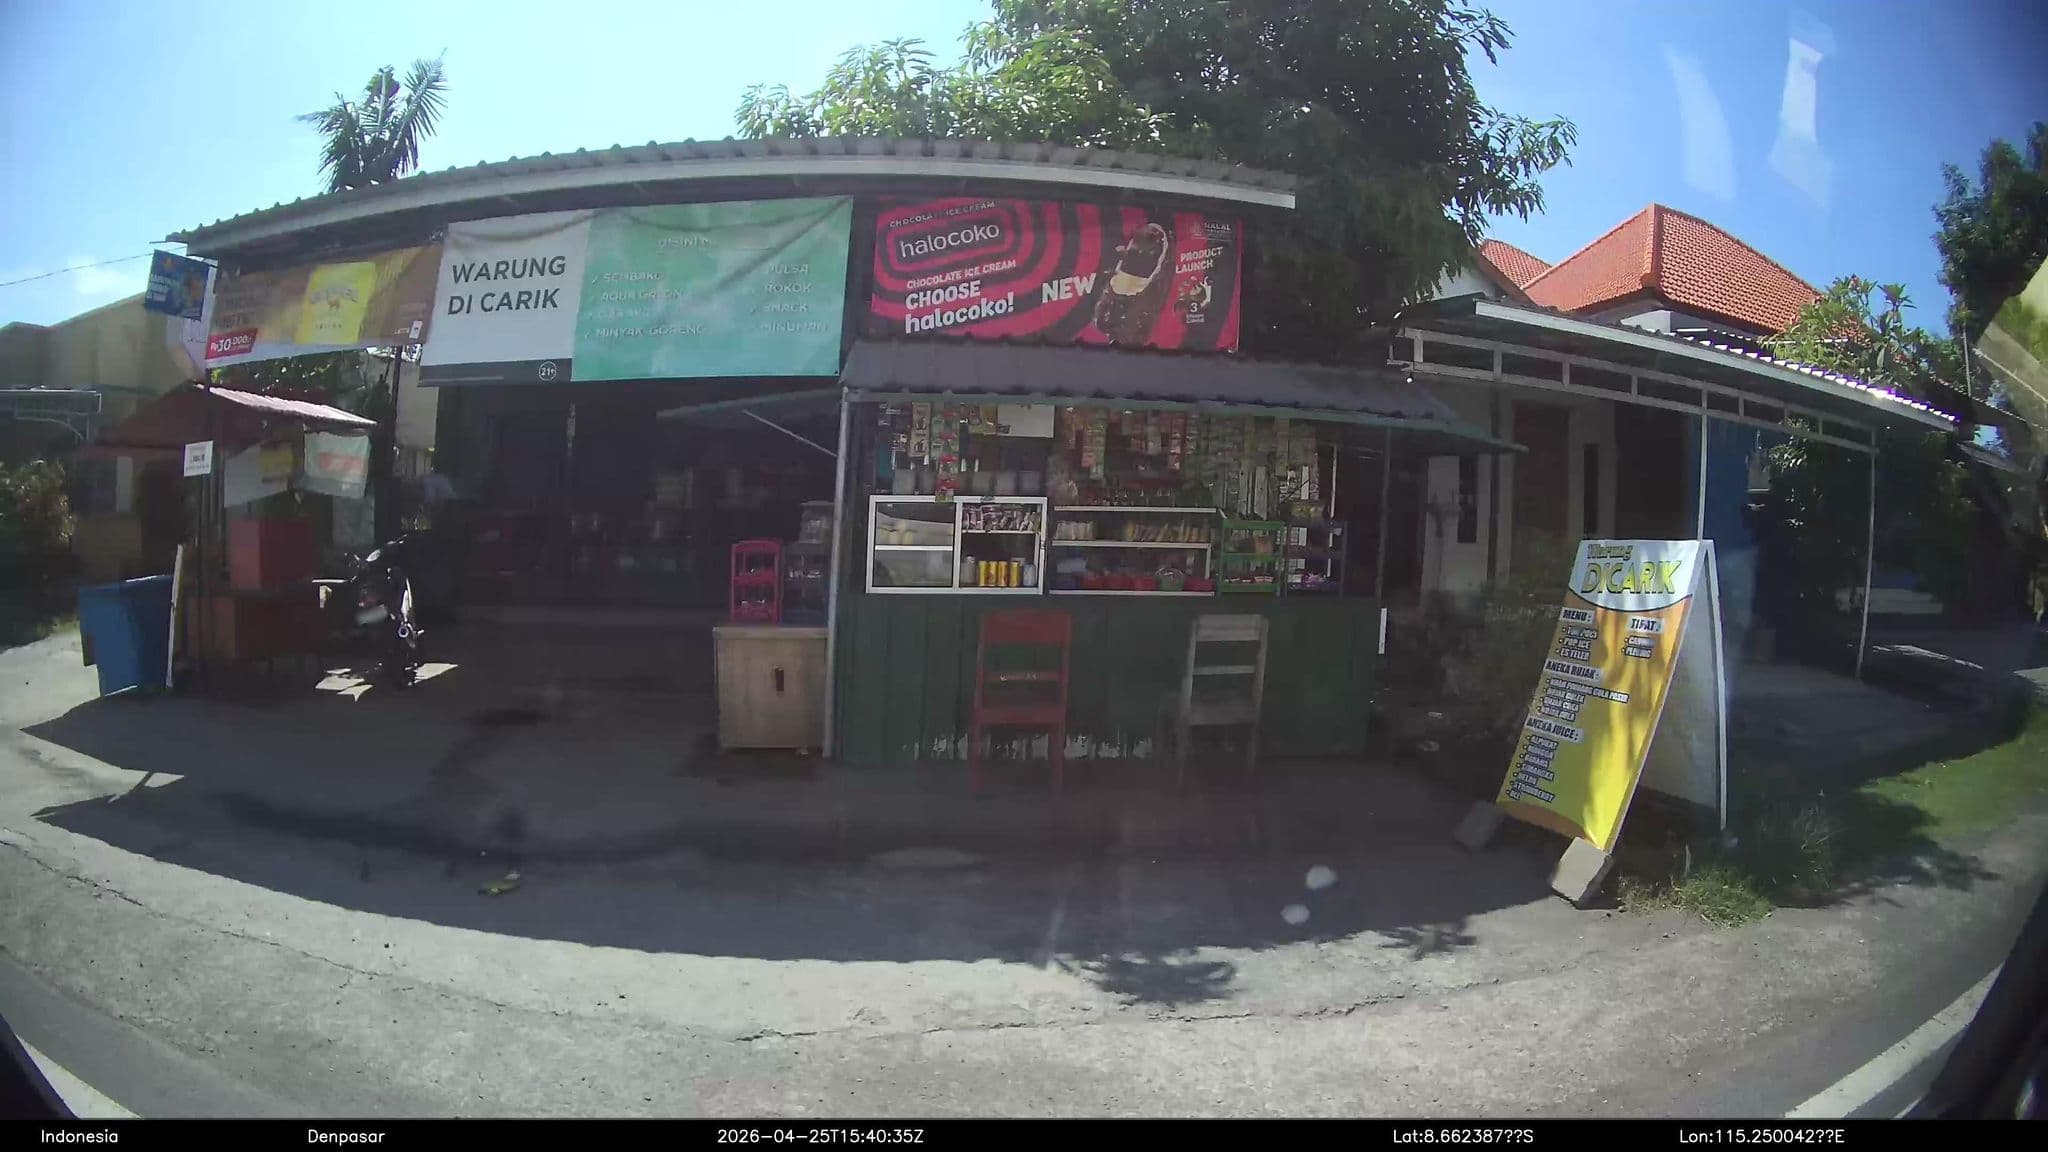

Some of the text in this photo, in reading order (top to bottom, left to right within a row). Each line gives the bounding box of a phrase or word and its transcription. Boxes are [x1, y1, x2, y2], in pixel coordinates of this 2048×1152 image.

[889, 211, 937, 228] CHOCOLA
[901, 224, 1000, 258] halocoko
[1180, 246, 1223, 262] PRODUCT
[452, 255, 566, 285] WARUNG
[907, 259, 1016, 289] CHOCOLATE ICE CREAM
[1175, 259, 1214, 274] LAUNCH
[447, 288, 560, 315] DI CARIK
[905, 280, 981, 310] CHOOSE
[1042, 272, 1096, 304] NEW
[905, 291, 1015, 334] halocoko!
[1190, 302, 1198, 313] 3
